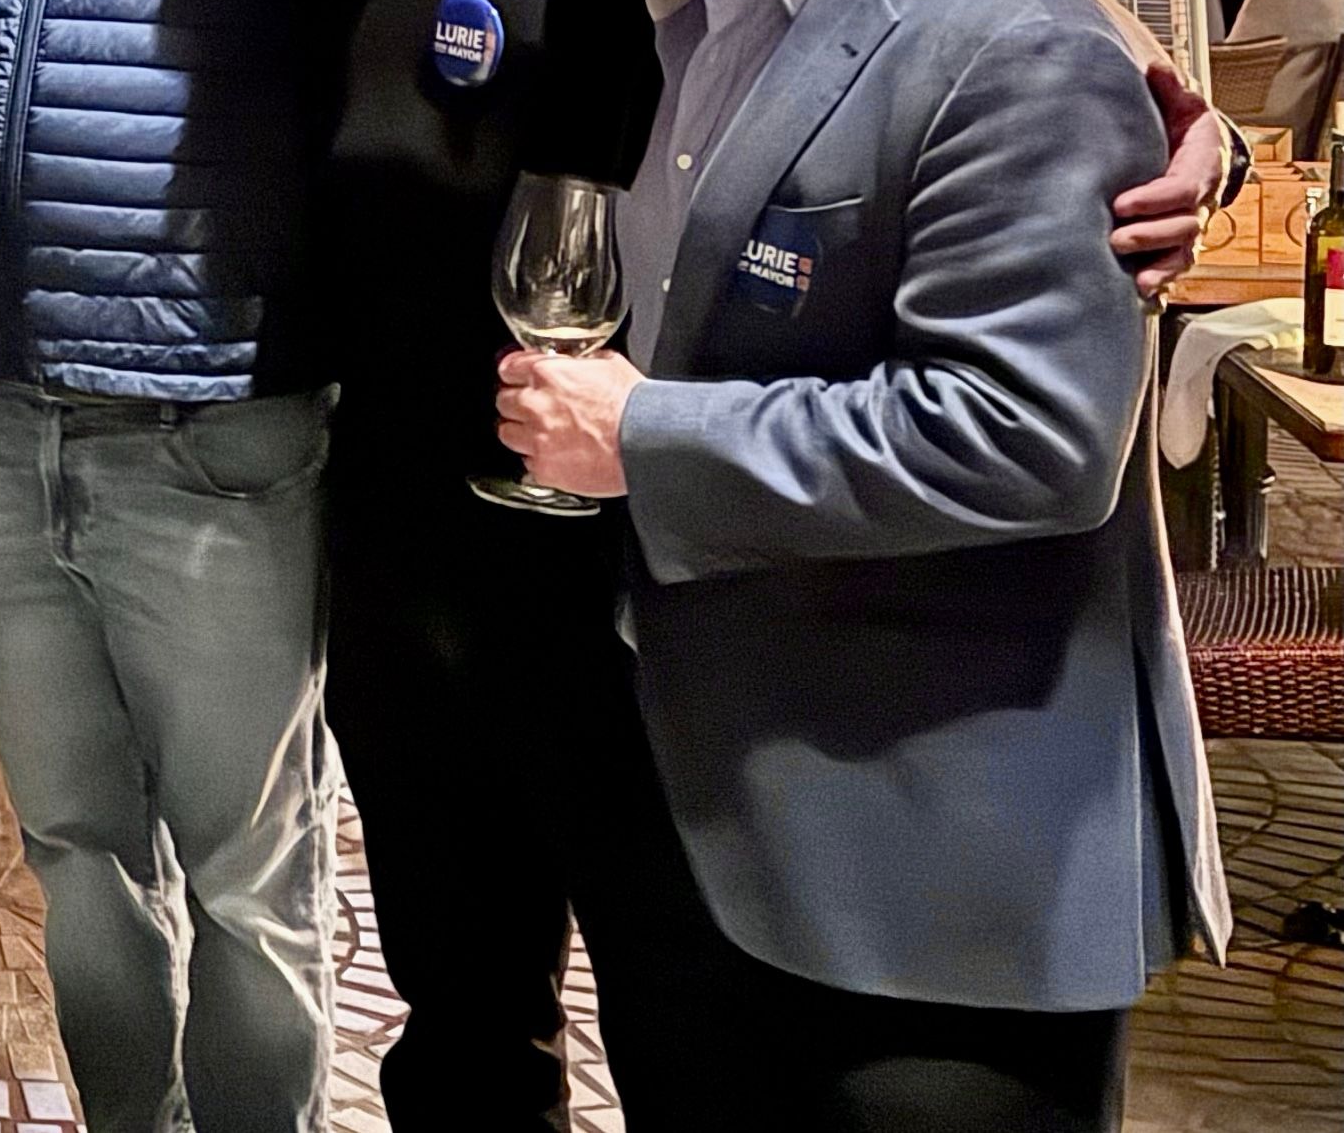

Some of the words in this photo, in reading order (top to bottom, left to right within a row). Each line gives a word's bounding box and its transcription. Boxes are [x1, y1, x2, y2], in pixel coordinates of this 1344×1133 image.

[436, 21, 485, 49] LURIE
[448, 45, 482, 63] MAYOR
[741, 240, 799, 274] URIE
[749, 264, 795, 288] MAYOR
